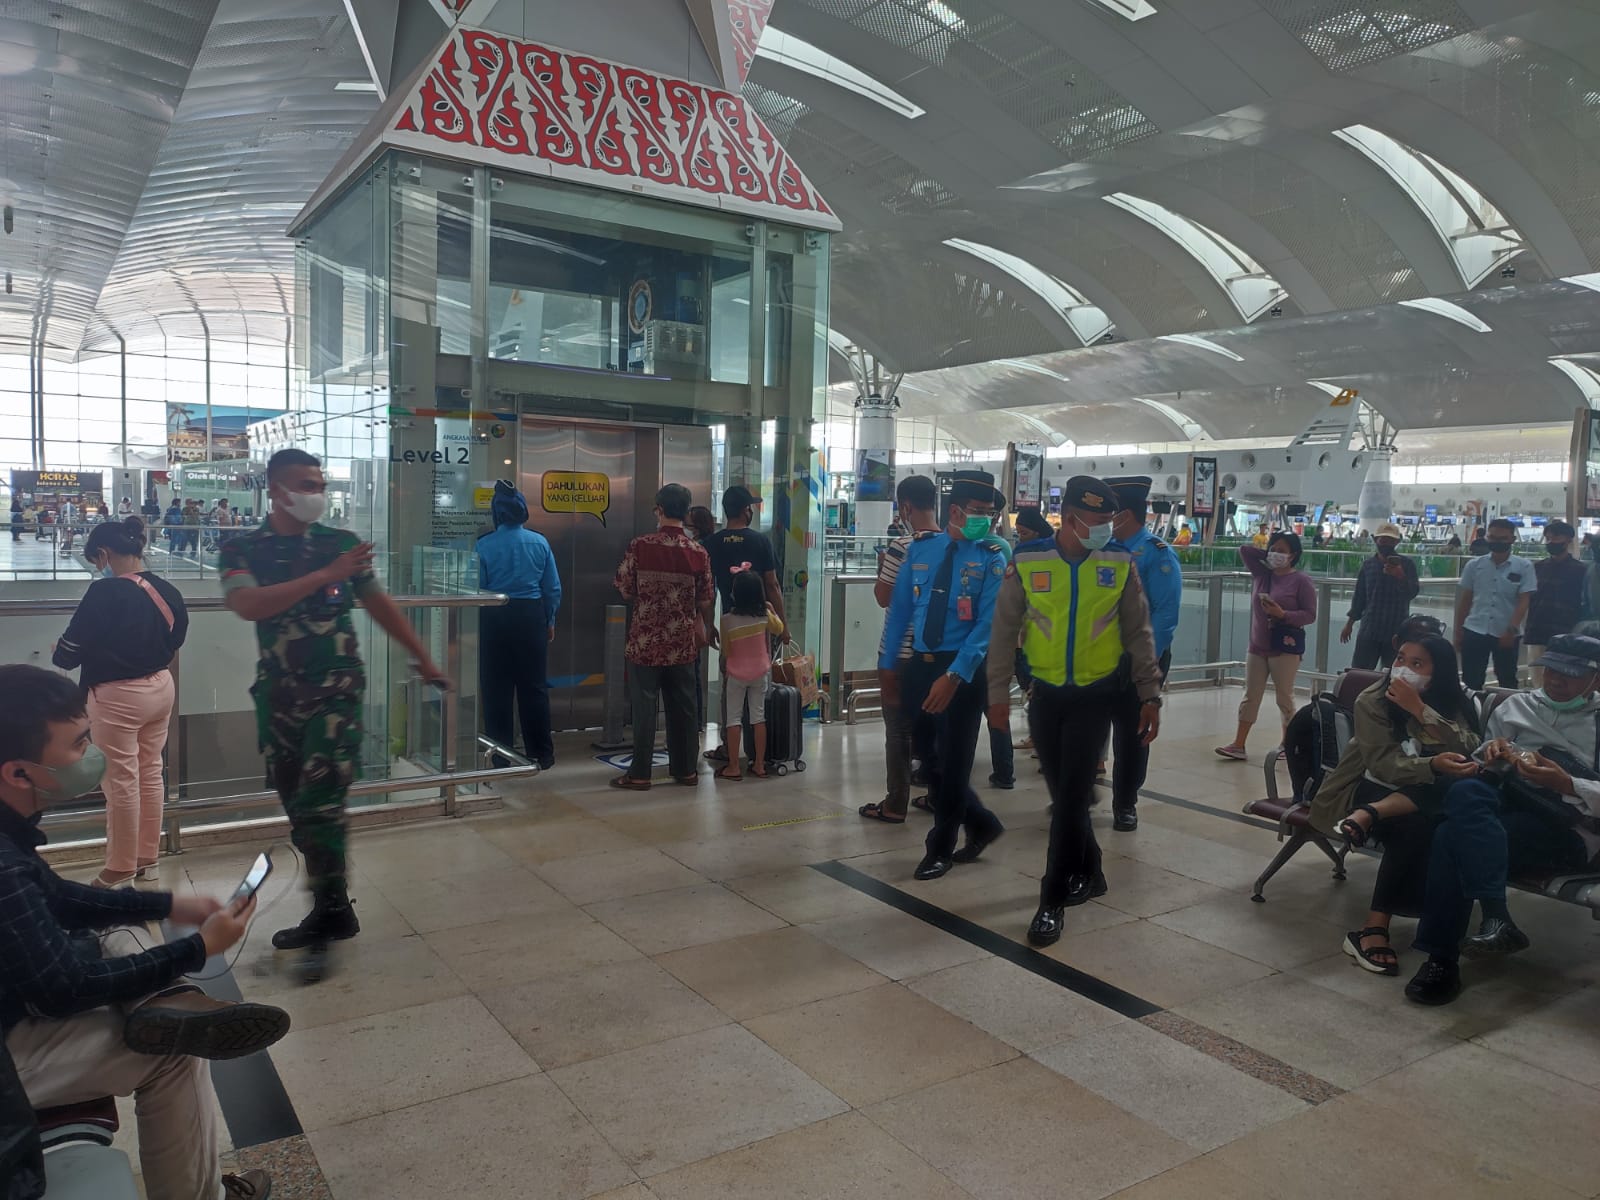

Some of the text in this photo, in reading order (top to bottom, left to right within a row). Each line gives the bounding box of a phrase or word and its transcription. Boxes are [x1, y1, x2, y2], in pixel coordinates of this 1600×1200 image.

[443, 434, 470, 442] ANGKASA
[389, 445, 470, 465] Level 2
[39, 473, 77, 481] HORAS
[546, 481, 605, 491] DAHULUKAN
[546, 494, 605, 503] YANG KELUAR
